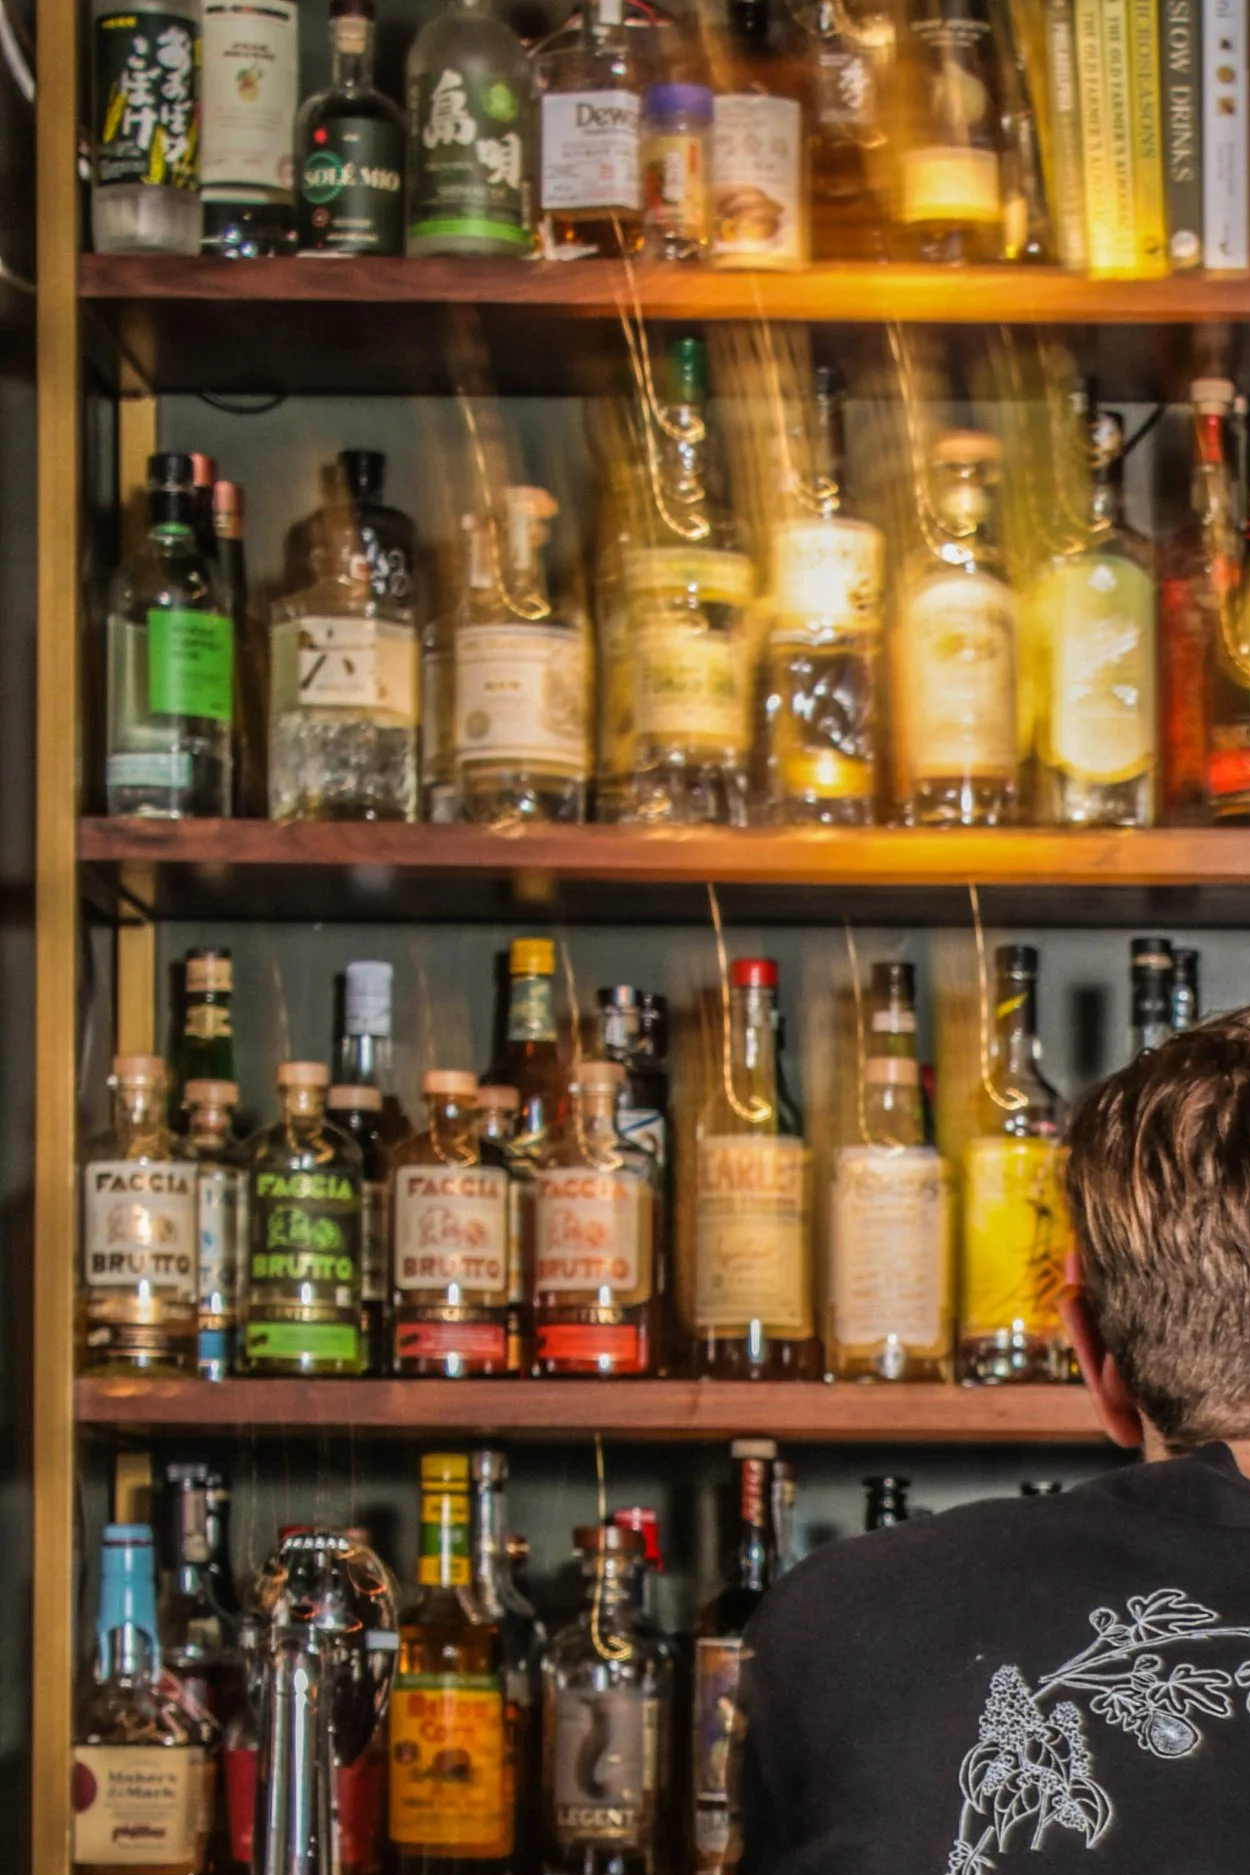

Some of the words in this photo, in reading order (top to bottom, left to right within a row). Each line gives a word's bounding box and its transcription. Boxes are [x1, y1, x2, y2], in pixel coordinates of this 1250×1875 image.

[1107, 15, 1120, 43] THE
[1109, 48, 1122, 78] OLD
[1110, 83, 1126, 155] FARMER'S
[1170, 84, 1195, 182] DRINKS
[95, 1172, 189, 1196] FACCIA
[256, 1171, 353, 1199] FACCIA
[407, 1176, 500, 1199] FACCIA
[92, 1252, 191, 1276] BRUTTO
[252, 1252, 354, 1281] BRUTTO
[403, 1257, 501, 1280] BRUTTO
[538, 1258, 630, 1281] BRUTTO
[557, 1806, 635, 1829] LEGENT
